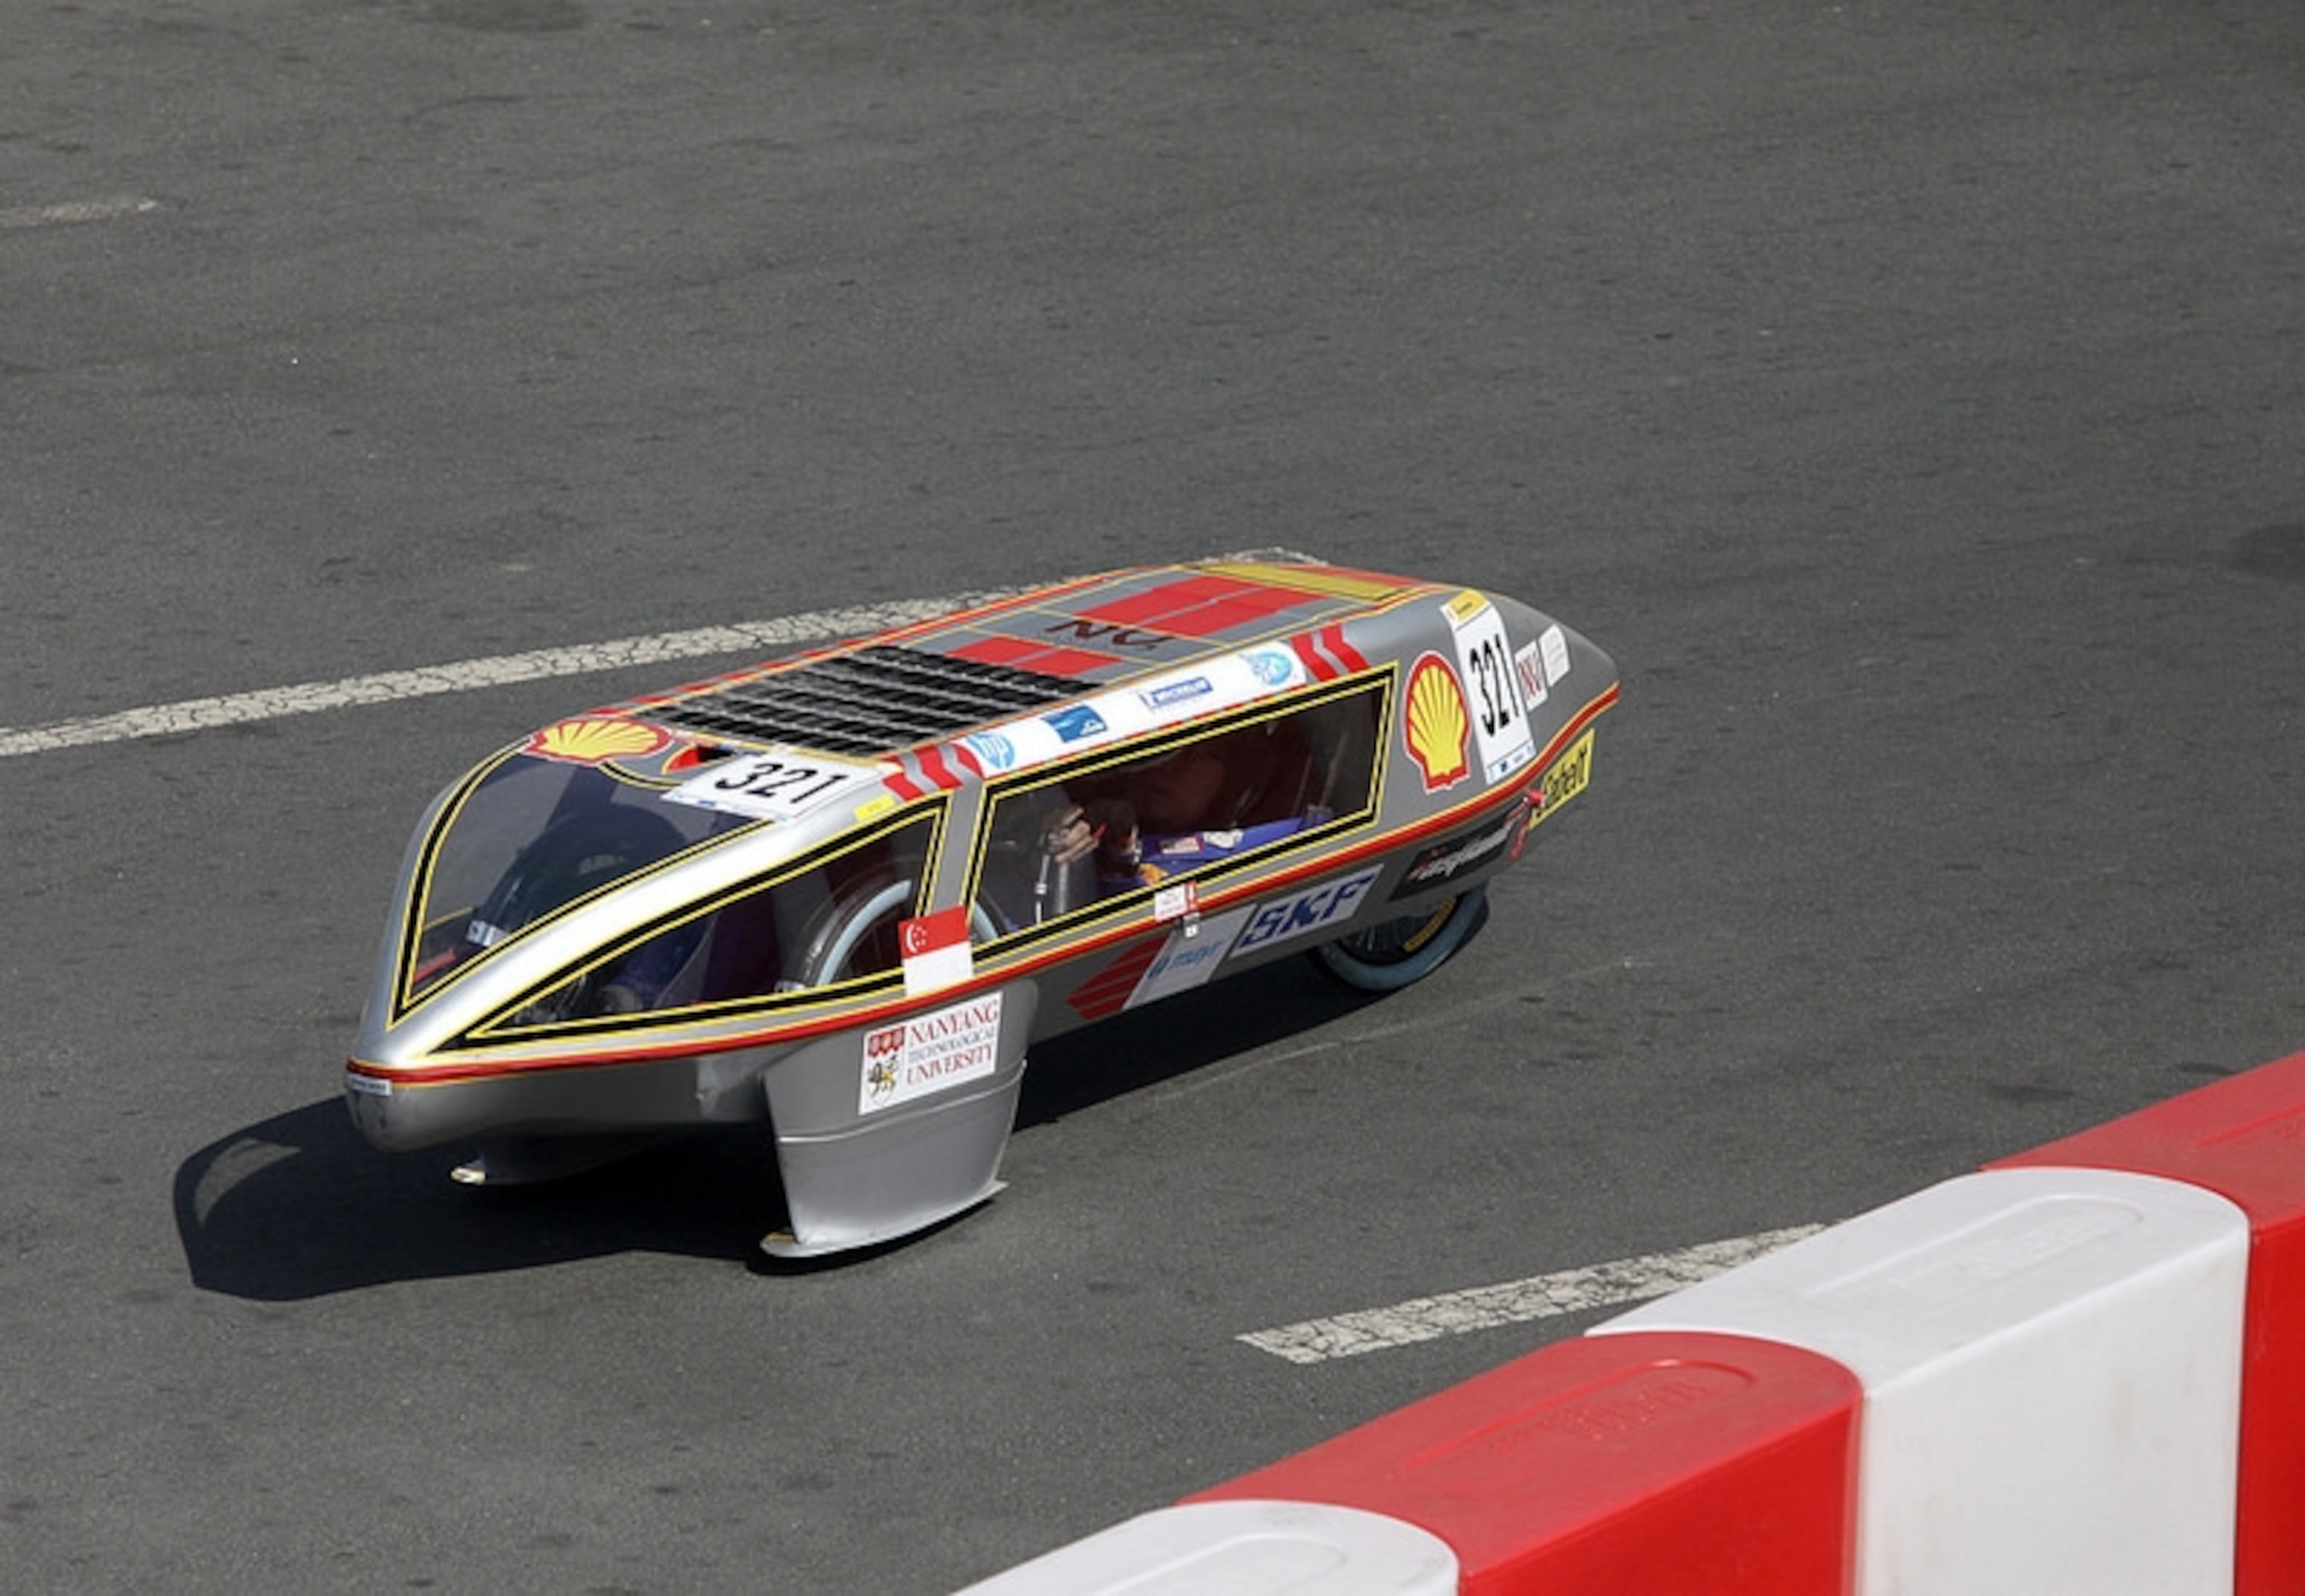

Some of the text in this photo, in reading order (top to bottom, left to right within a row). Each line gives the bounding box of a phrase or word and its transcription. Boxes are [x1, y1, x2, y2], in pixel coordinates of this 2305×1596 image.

[1470, 634, 1519, 736] 321
[715, 763, 849, 804] 321
[1240, 873, 1375, 947] SKF
[909, 999, 999, 1047] NANYANG
[906, 1043, 993, 1084] UNIVERSITY
